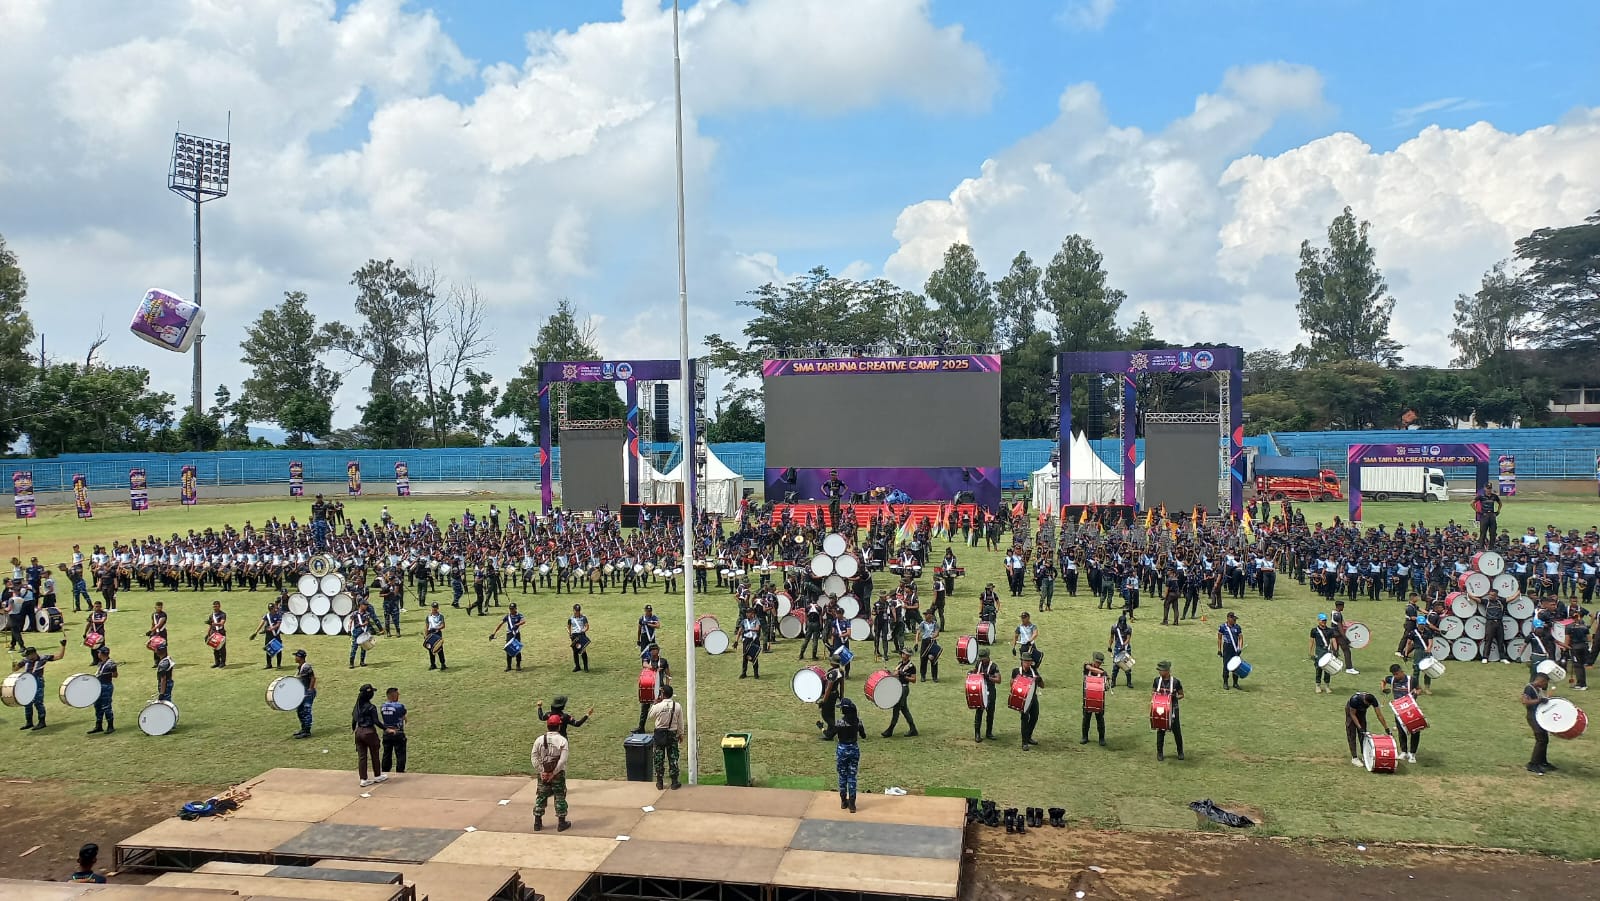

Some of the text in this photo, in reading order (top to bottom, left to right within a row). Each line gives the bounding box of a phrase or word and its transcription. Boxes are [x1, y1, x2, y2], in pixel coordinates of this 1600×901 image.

[793, 359, 969, 372] SMA TARUNA CREATIVE CAMP 2025
